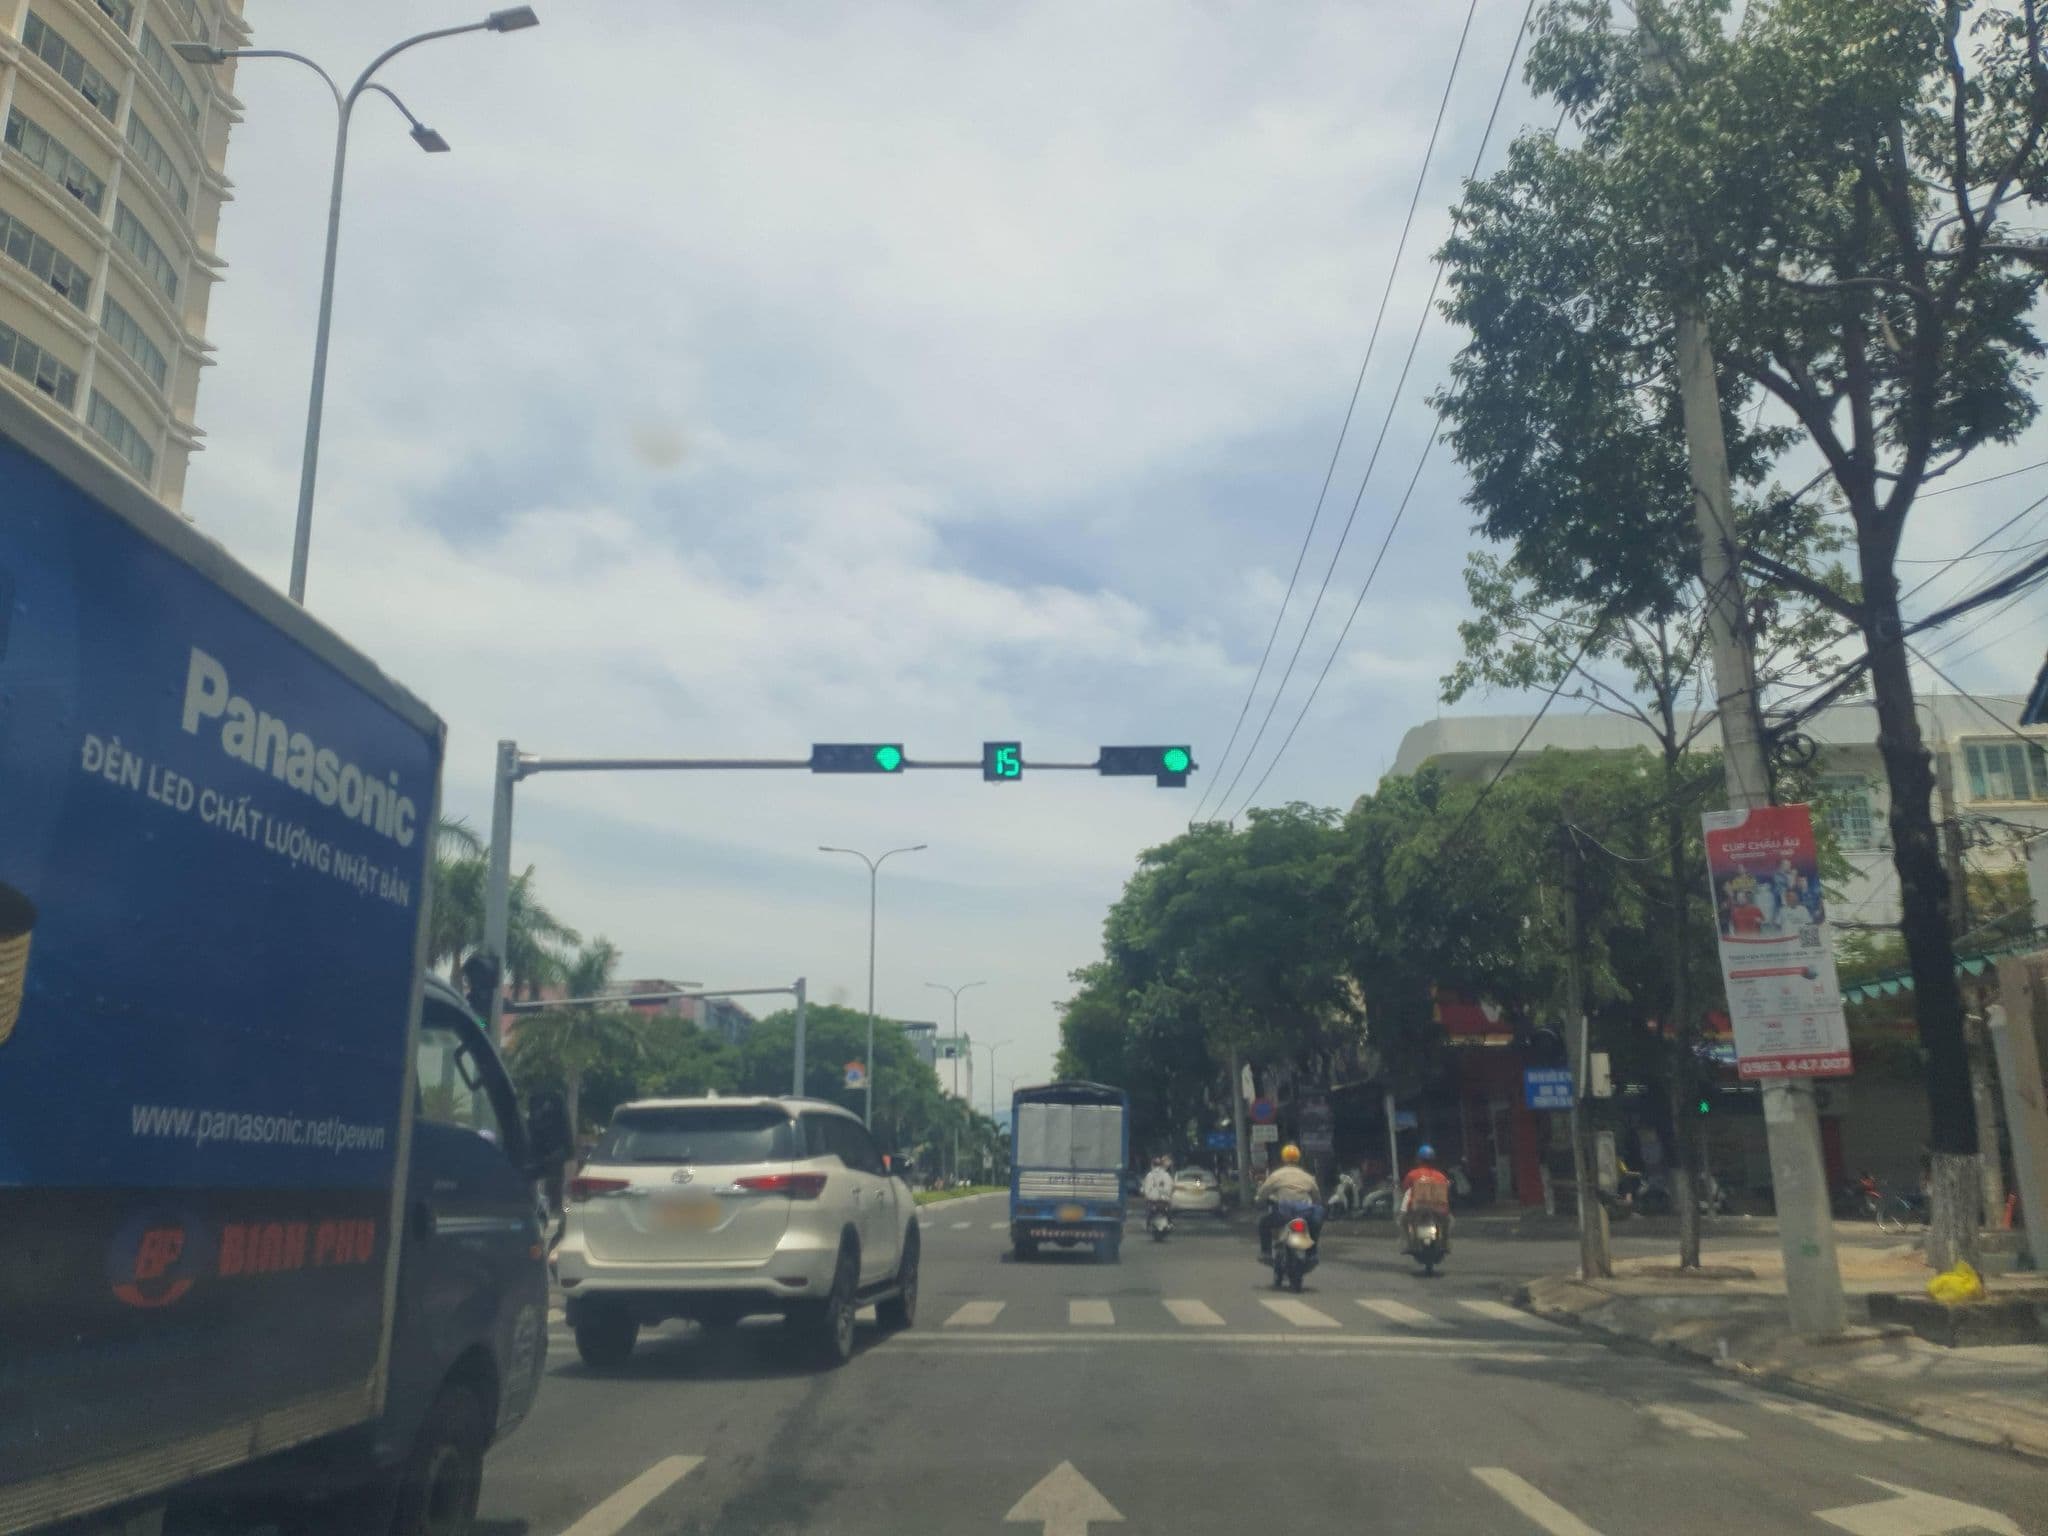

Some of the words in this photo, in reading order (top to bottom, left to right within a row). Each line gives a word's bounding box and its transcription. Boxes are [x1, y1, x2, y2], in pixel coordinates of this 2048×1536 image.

[182, 646, 415, 847] Panasonic
[996, 747, 1019, 777] 15
[82, 733, 143, 791] ĐÈN
[147, 764, 195, 812] LED
[200, 788, 263, 840] CHẤT
[265, 817, 330, 872] LƯỢNG
[132, 1103, 386, 1155] www.panasonic.net/pewvn
